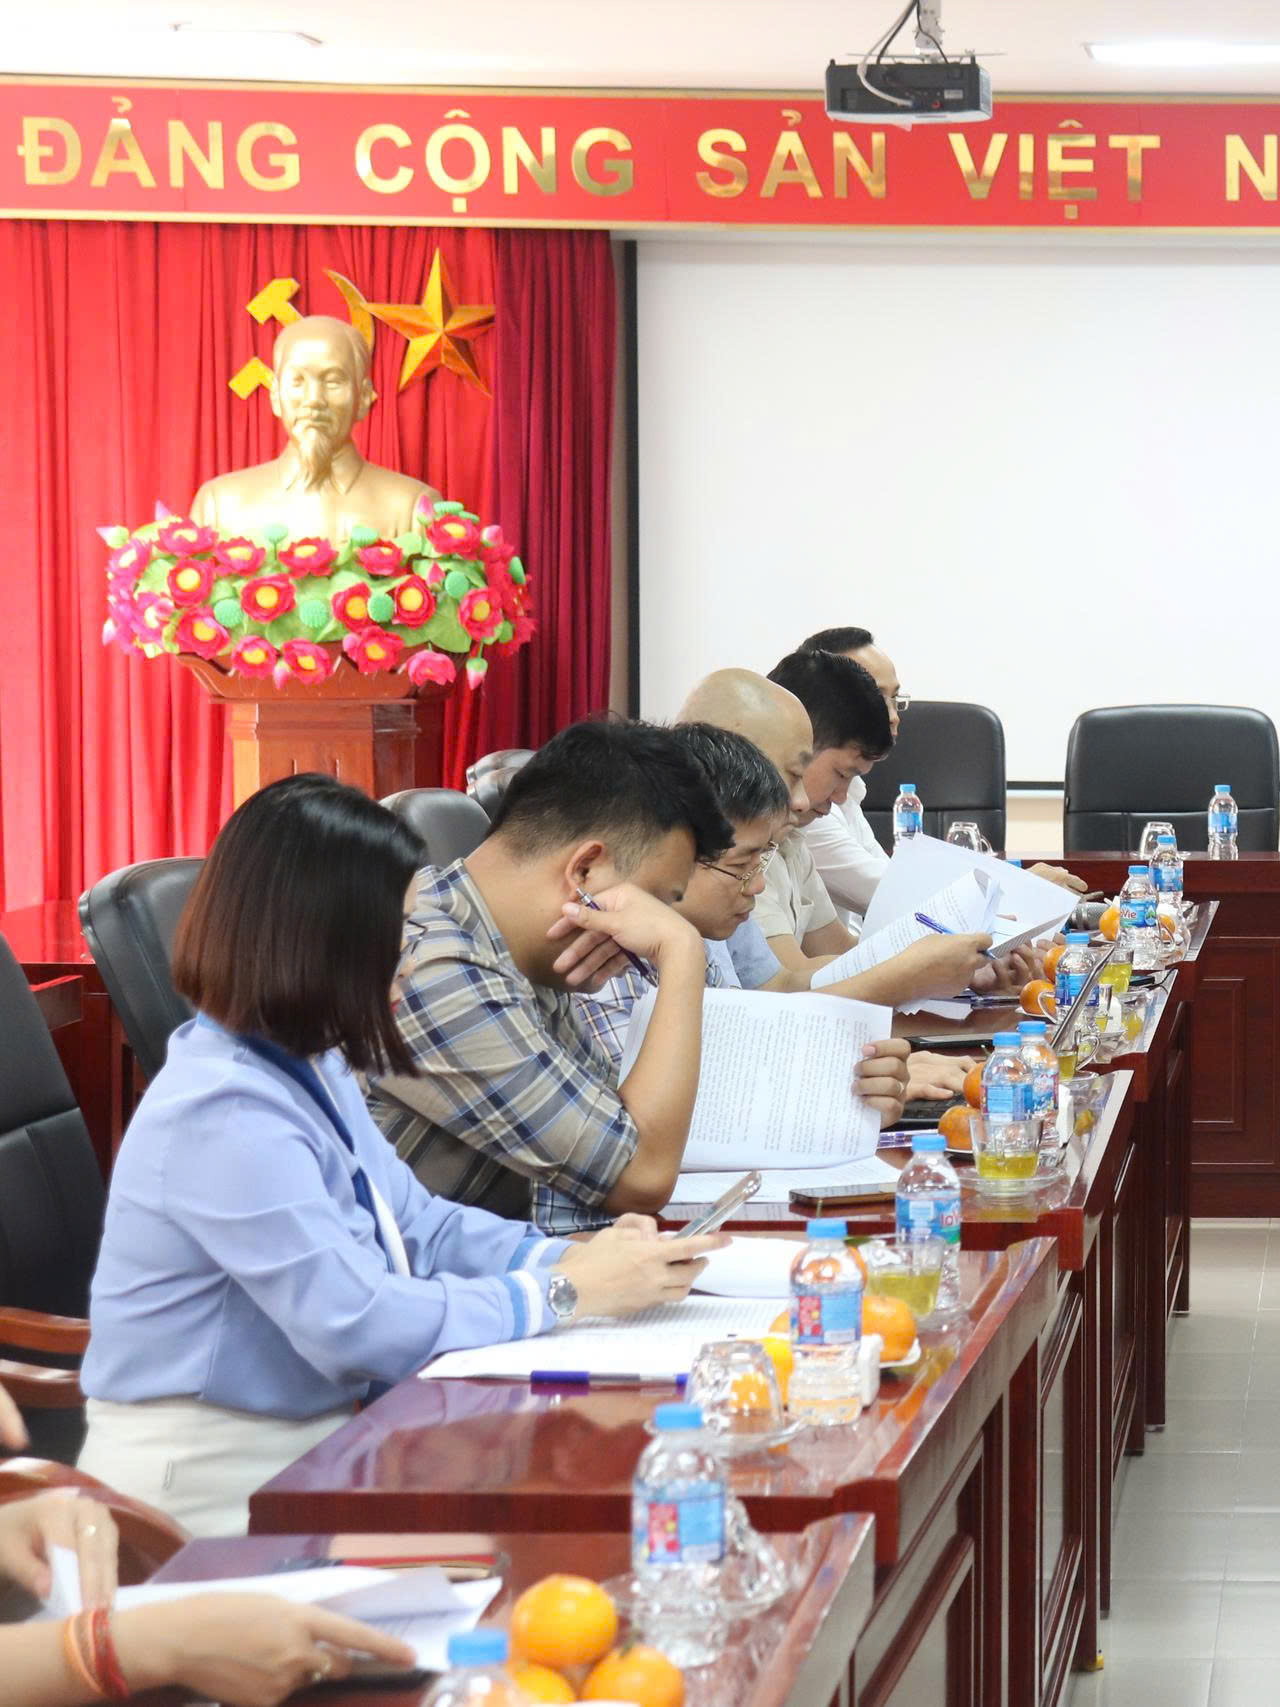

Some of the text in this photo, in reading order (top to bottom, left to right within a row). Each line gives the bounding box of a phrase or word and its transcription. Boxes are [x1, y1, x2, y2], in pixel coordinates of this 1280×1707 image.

[16, 96, 302, 192] ĐẢNG
[354, 108, 635, 214] CỘNG
[695, 111, 887, 200] SẢN
[947, 119, 1161, 221] VIỆT
